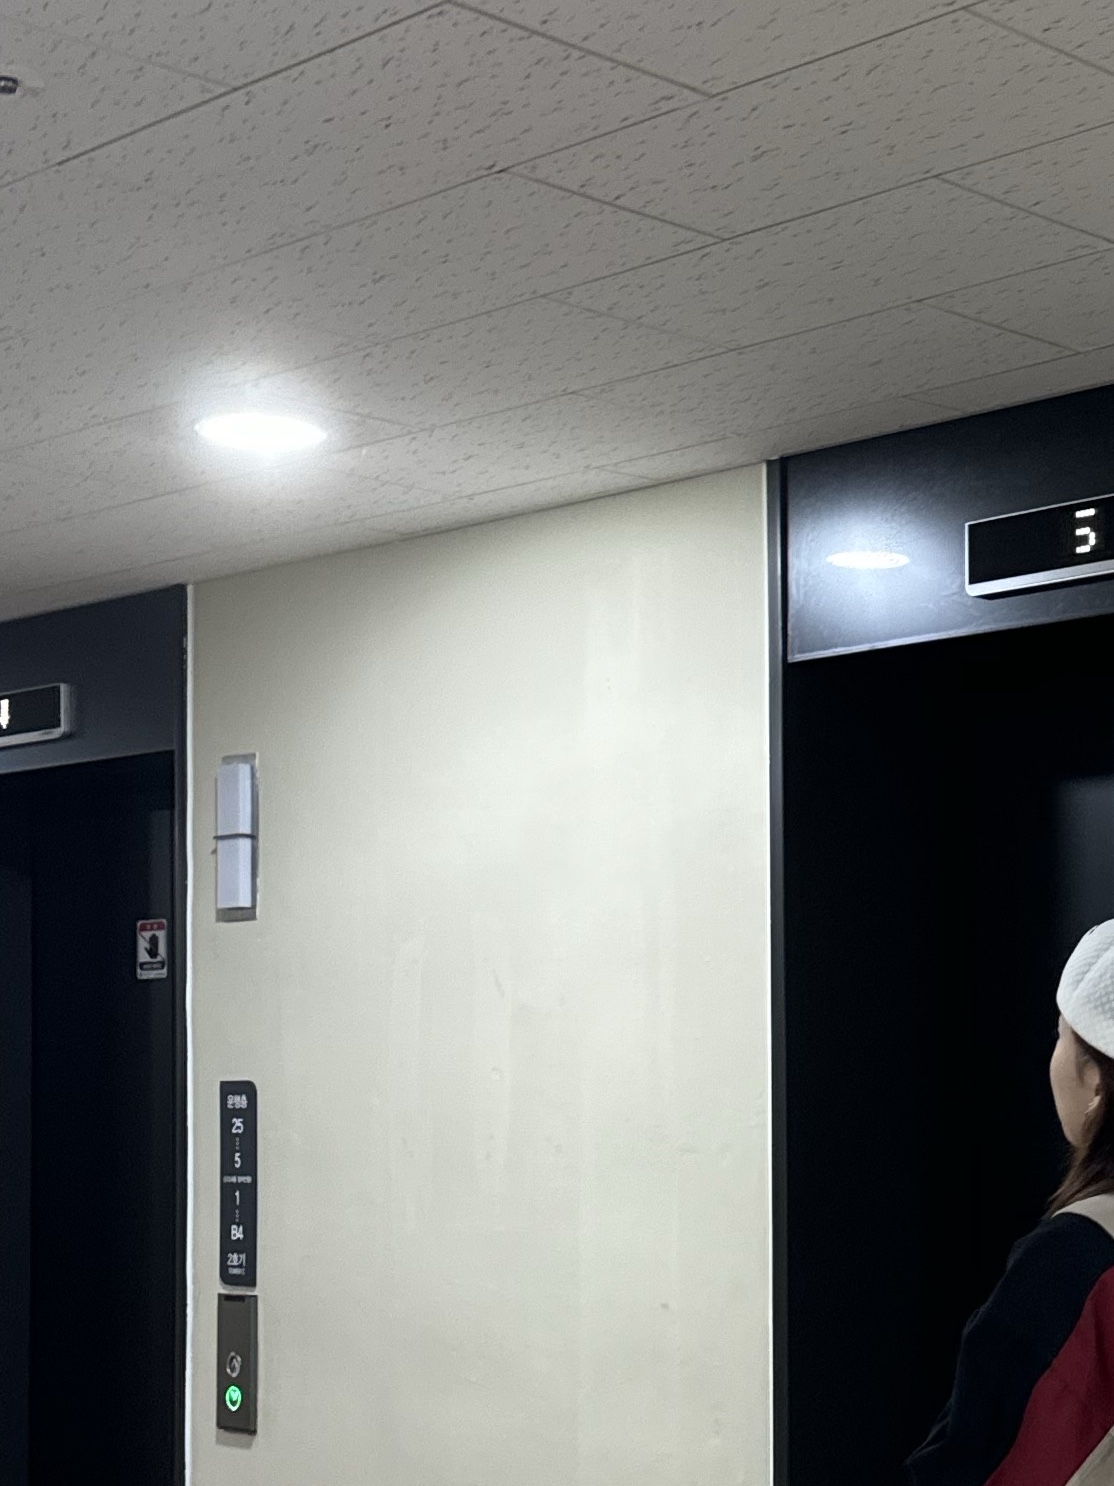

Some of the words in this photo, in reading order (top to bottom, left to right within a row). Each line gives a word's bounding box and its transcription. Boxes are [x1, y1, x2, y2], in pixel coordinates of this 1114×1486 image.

[1074, 507, 1096, 554] 5
[232, 1117, 244, 1134] 25
[234, 1152, 242, 1169] 5
[234, 1190, 240, 1206] 1
[230, 1224, 244, 1241] B4
